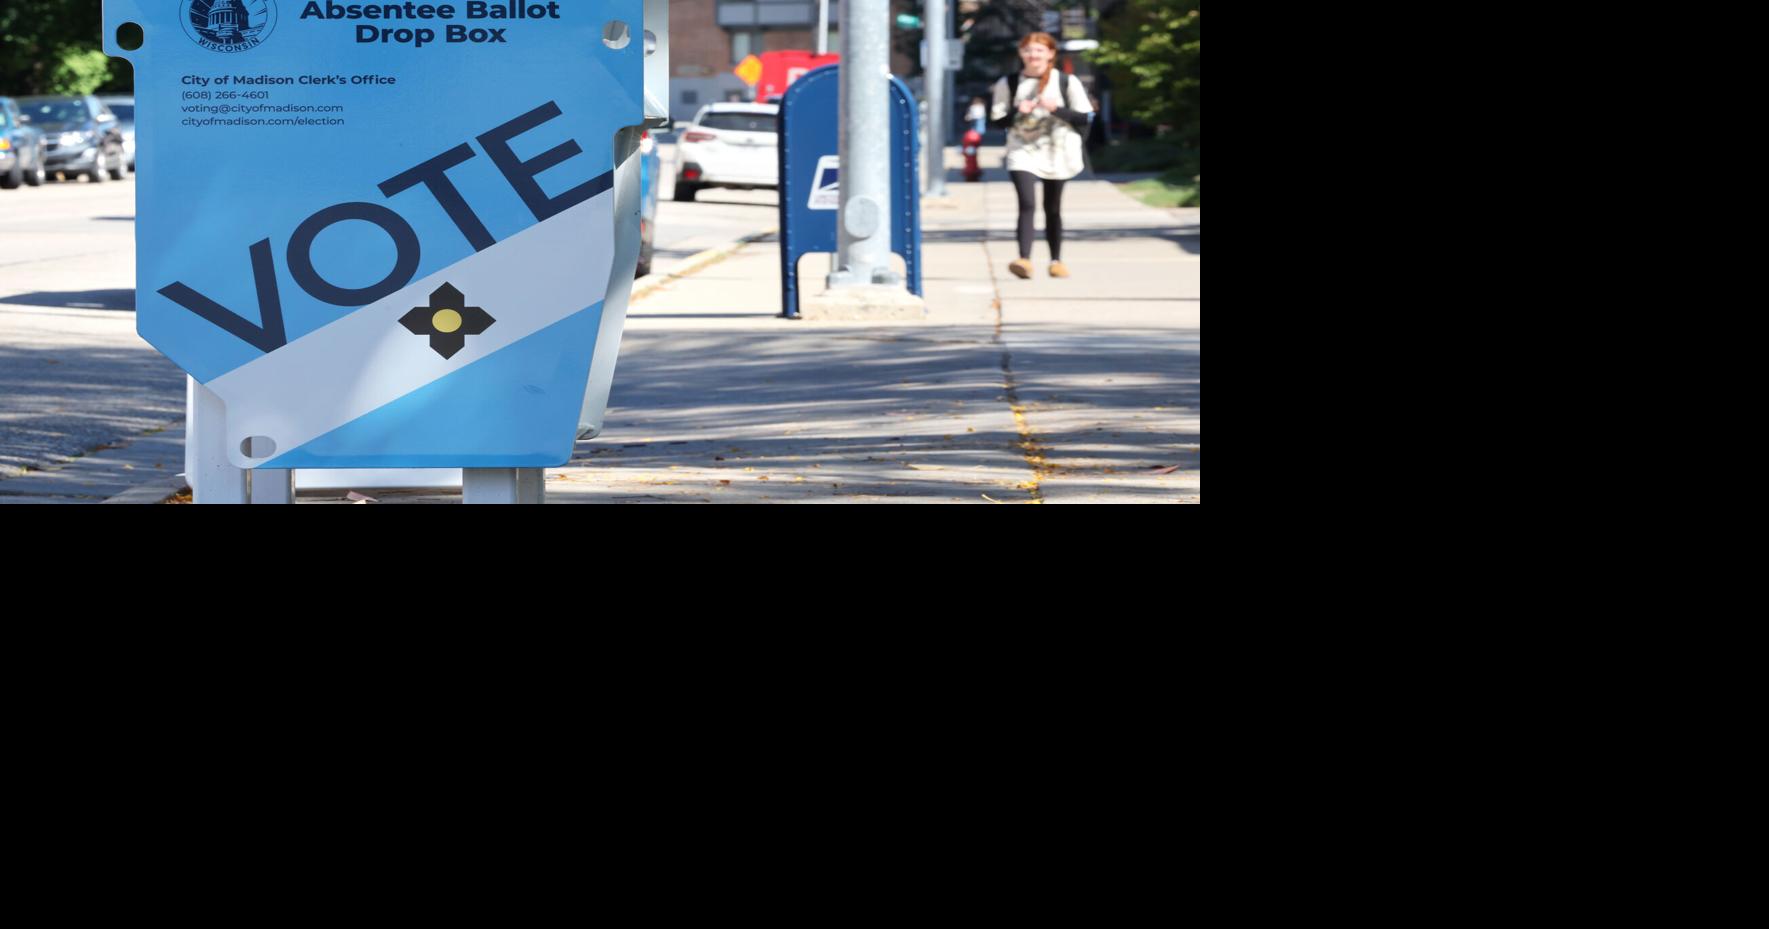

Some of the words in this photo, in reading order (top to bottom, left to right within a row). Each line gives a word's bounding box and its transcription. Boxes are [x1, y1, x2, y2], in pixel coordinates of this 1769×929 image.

[299, 0, 456, 20] Absentee
[466, 0, 561, 20] Ballot
[355, 24, 435, 48] Drop
[445, 24, 507, 44] Box
[198, 37, 261, 53] WISCONSIN
[181, 74, 211, 88] City
[213, 74, 230, 87] of
[233, 74, 295, 87] Madison
[298, 74, 347, 87] Clerk's
[350, 74, 397, 87] Office
[181, 90, 212, 101] (608)
[215, 90, 269, 101] 266-4601
[181, 103, 344, 115] voting@cityofmadison.com
[181, 116, 345, 128] cityofmadison.com/election
[156, 100, 614, 354] VOTE
